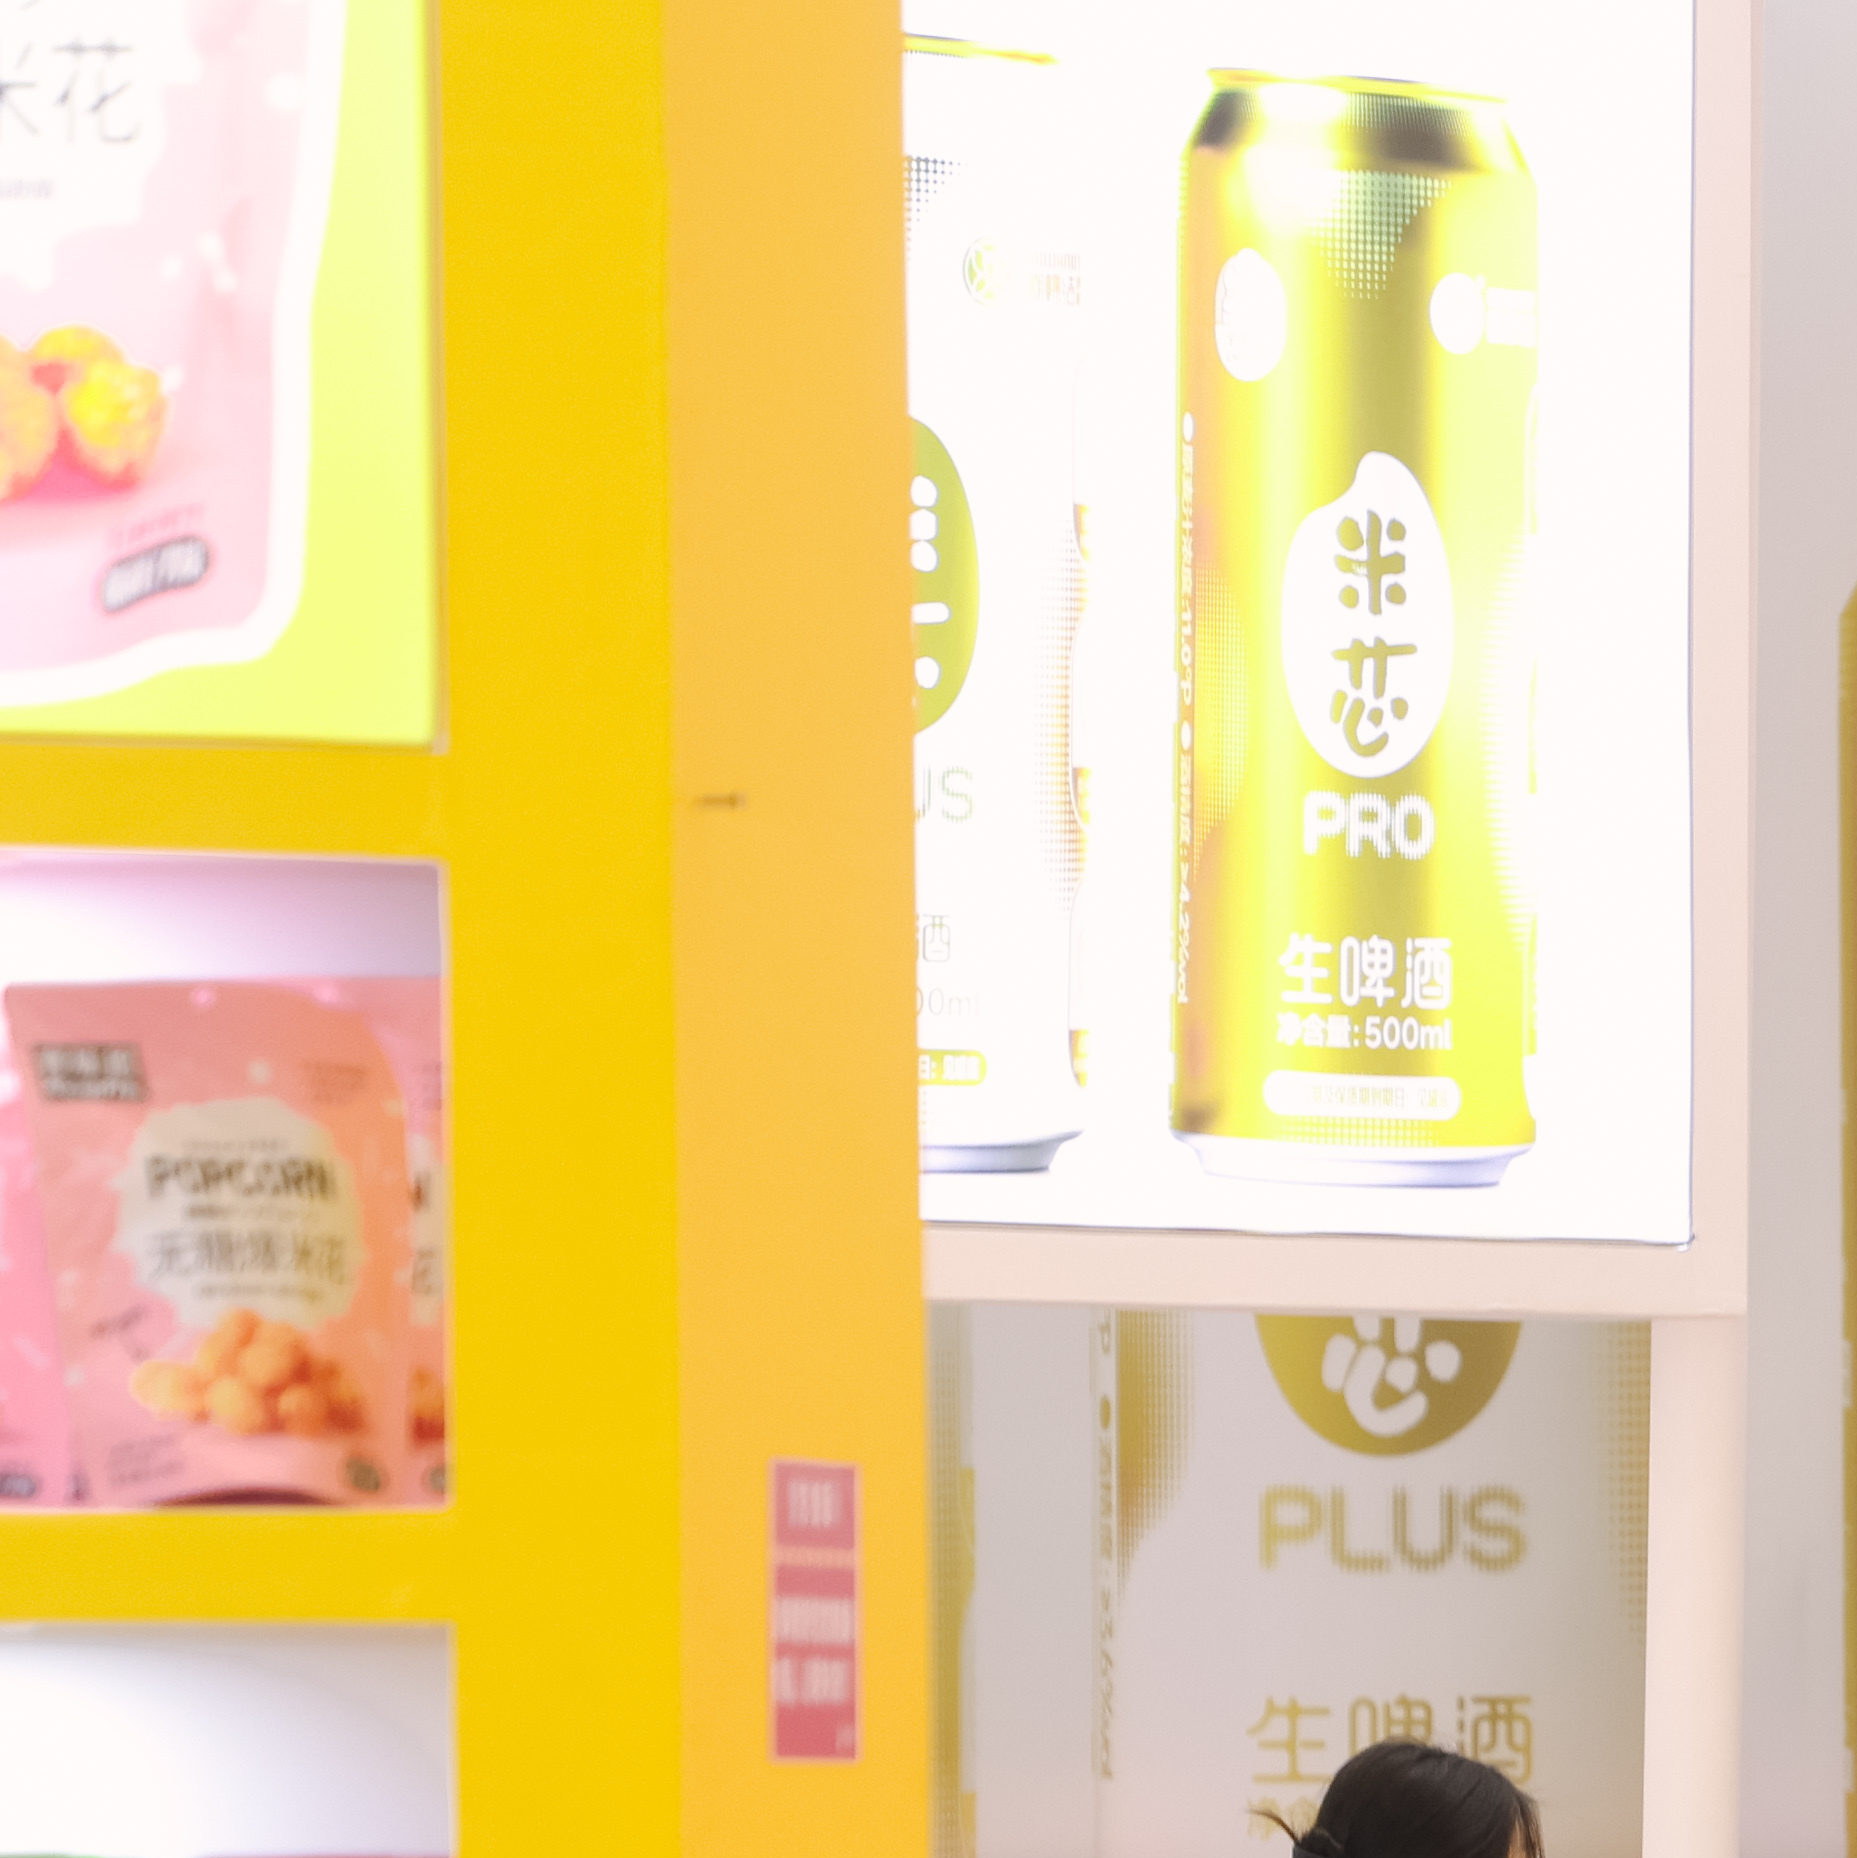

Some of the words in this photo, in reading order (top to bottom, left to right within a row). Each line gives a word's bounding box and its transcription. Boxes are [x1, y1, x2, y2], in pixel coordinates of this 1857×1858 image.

[1329, 509, 1419, 759] 米芯
[1301, 788, 1437, 861] PRO
[1276, 932, 1455, 1011] 生啤酒
[1258, 1483, 1529, 1576] PLUS
